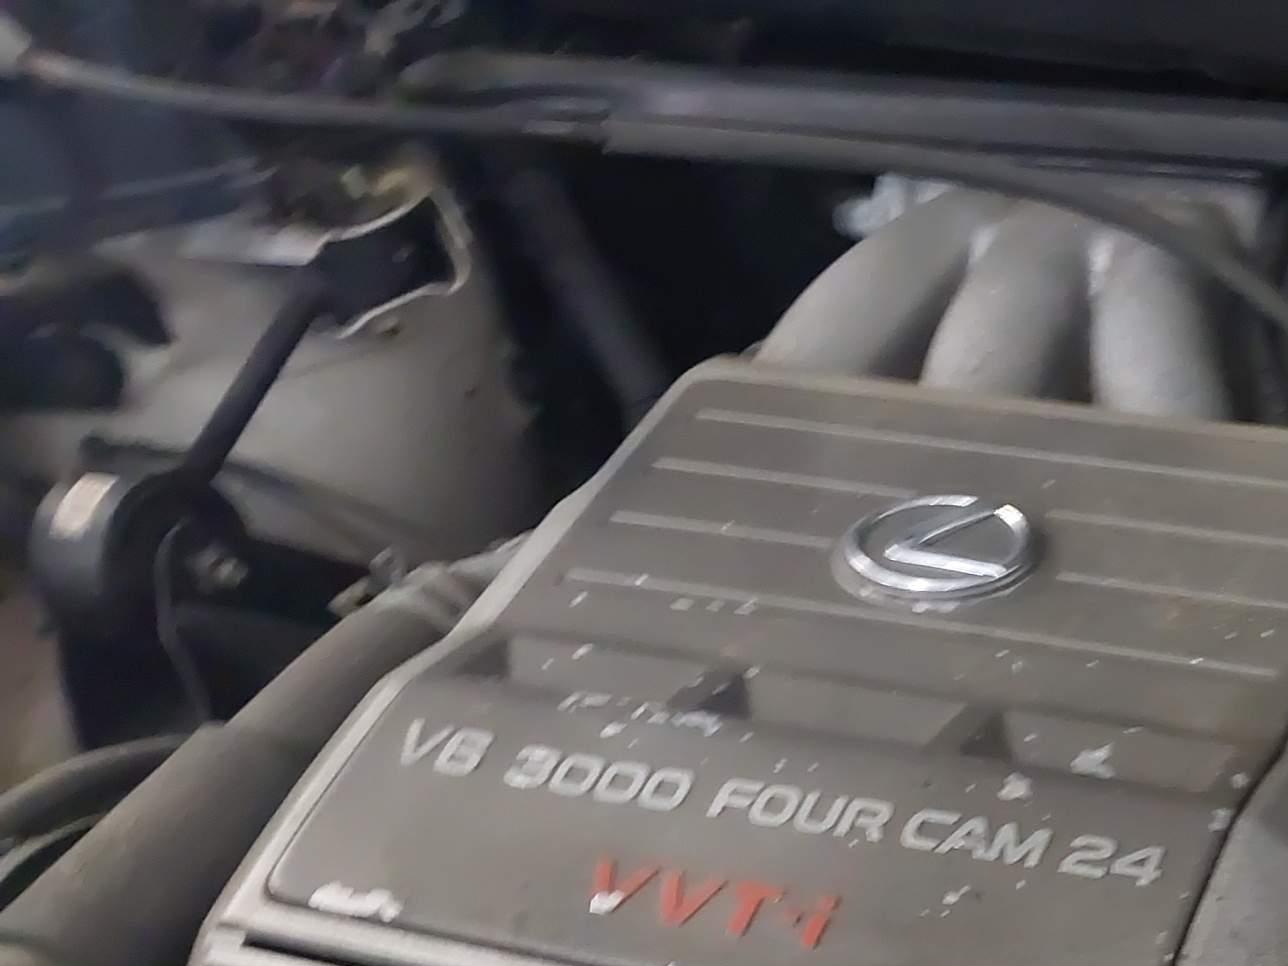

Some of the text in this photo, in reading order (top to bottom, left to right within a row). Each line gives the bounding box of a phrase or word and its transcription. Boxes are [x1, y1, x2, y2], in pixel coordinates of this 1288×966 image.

[401, 717, 1166, 888] V6 3000 FOUR CAM 24
